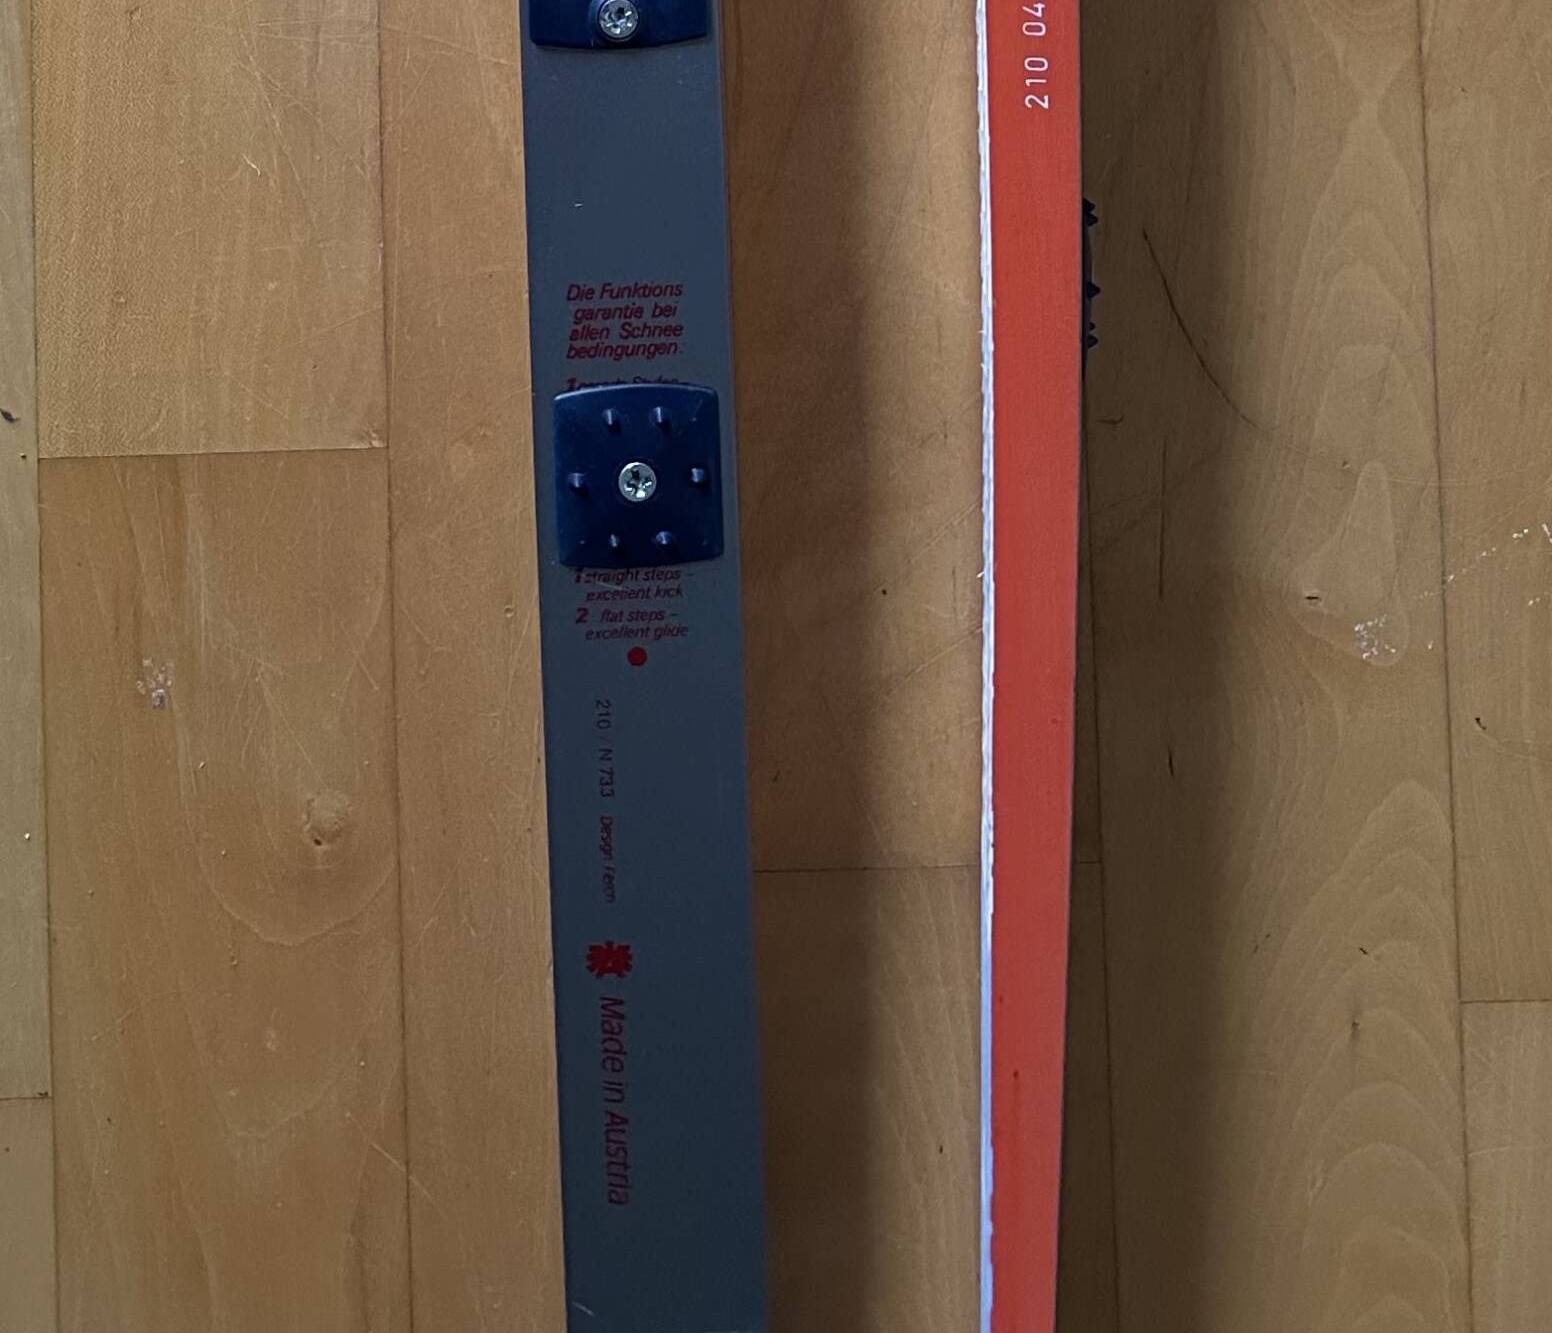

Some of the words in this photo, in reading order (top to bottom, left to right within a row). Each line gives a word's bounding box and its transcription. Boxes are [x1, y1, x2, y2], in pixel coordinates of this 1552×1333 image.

[1023, 56, 1049, 110] 210
[566, 284, 595, 301] Die
[599, 281, 684, 299] Funktions
[573, 302, 644, 325] garantie
[651, 300, 680, 318] bei
[569, 324, 610, 341] allen
[619, 322, 684, 340] Schnee
[642, 569, 681, 583] steps
[575, 607, 590, 624] 2
[600, 608, 624, 623] flat
[626, 609, 666, 623] steps
[585, 625, 650, 640] excellent
[595, 699, 612, 730] 210
[600, 996, 627, 1073] Made
[603, 1081, 629, 1103] in
[604, 1110, 632, 1205] Austria
